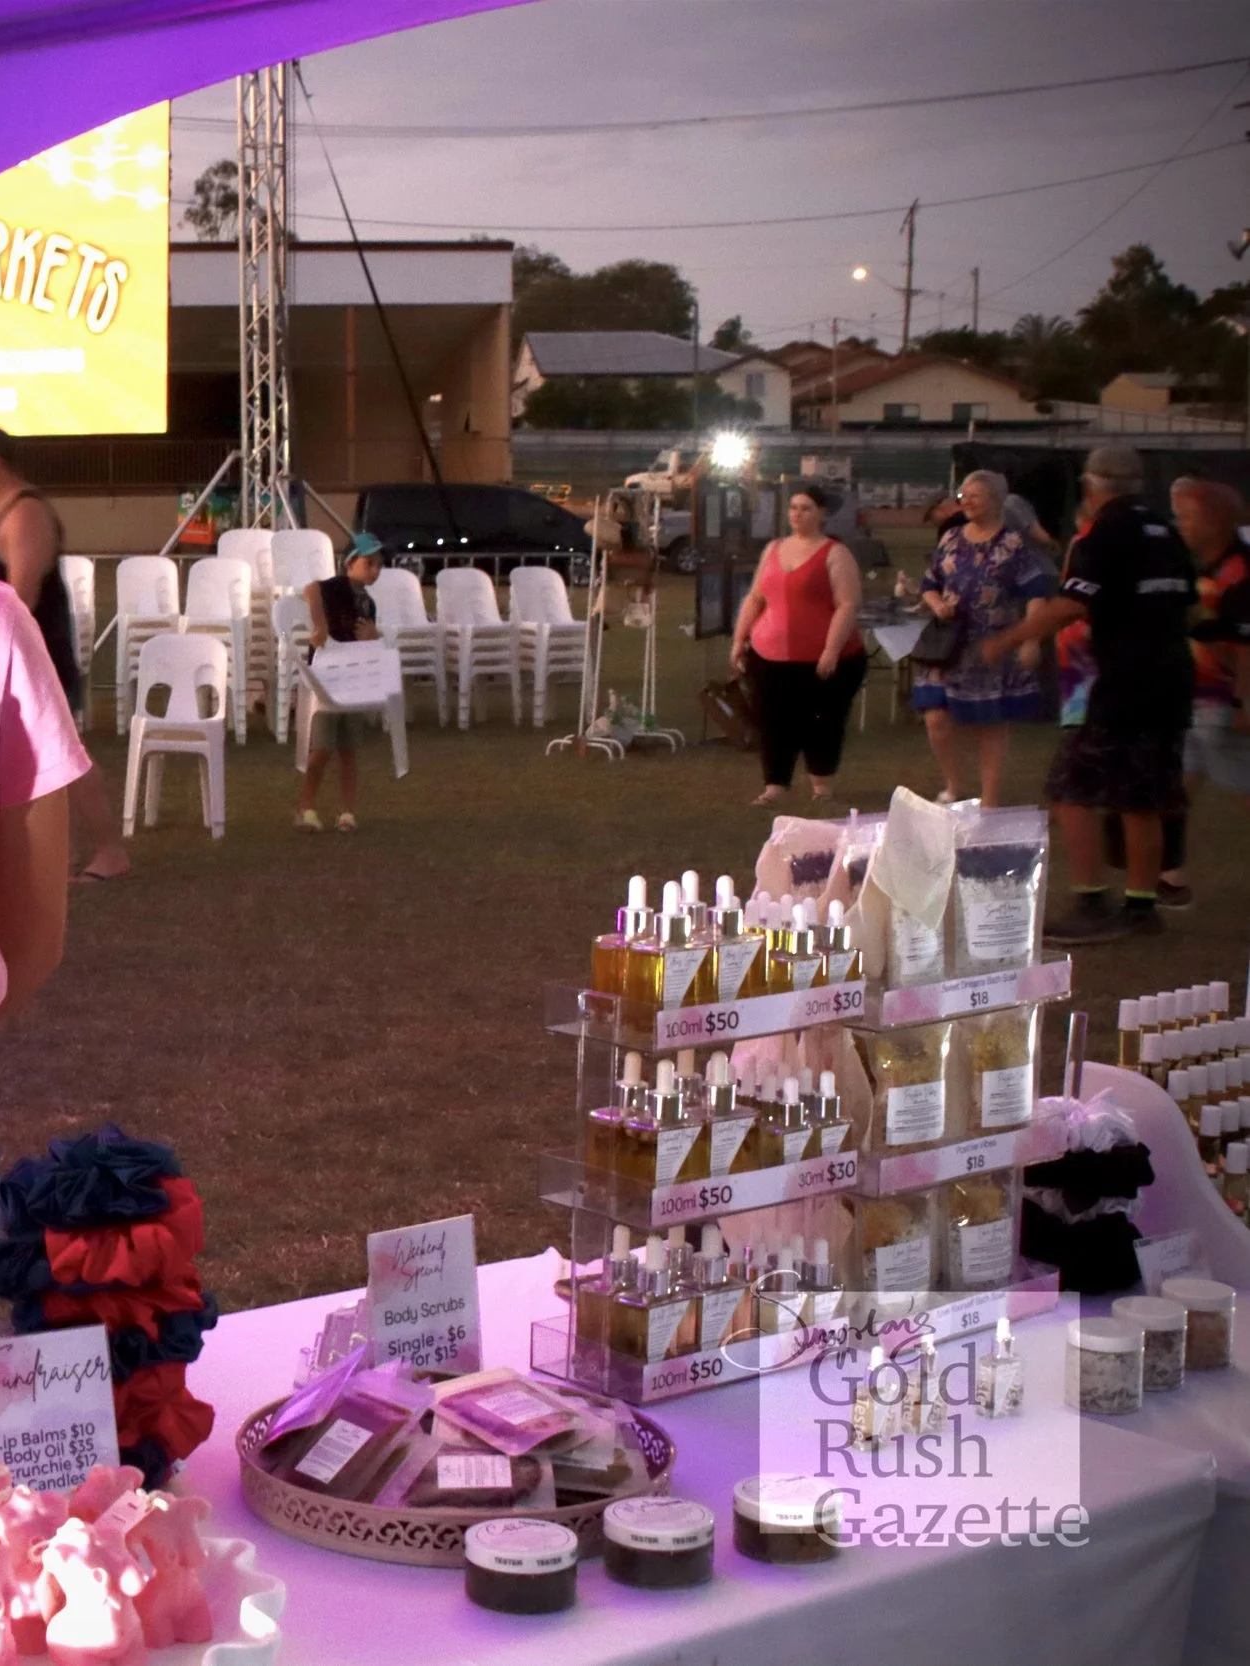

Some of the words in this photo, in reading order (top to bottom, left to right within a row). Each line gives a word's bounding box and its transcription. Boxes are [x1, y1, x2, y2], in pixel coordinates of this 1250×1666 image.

[970, 991, 989, 1009] $18
[666, 1019, 702, 1039] 100ml
[705, 1010, 739, 1036] $50
[805, 999, 831, 1016] 30ml
[832, 990, 862, 1014] $30
[966, 1154, 985, 1171] $18
[661, 1195, 696, 1216] 100ml
[699, 1184, 732, 1210] $50
[798, 1169, 824, 1188] 30ml
[827, 1160, 855, 1185] $30
[392, 1230, 446, 1271] Weekend
[402, 1253, 445, 1292] Special
[384, 1306, 418, 1325] Body
[420, 1297, 466, 1317] Scrubs
[961, 1311, 980, 1328] $18
[388, 1333, 435, 1357] Single
[447, 1325, 466, 1343] $6
[435, 1344, 459, 1363] $15
[651, 1370, 687, 1391] 100ml
[689, 1357, 722, 1384] $50
[21, 1429, 67, 1446] Balms
[70, 1422, 96, 1440] $10
[3, 1448, 41, 1465] Body
[45, 1443, 65, 1458] Oil
[68, 1437, 95, 1455] $35
[10, 1458, 72, 1480] runchie
[27, 1472, 86, 1492] Candles
[630, 1534, 659, 1545] TESTER
[672, 1534, 699, 1546] TESTER
[494, 1556, 523, 1567] TESTER
[536, 1556, 563, 1567] TESTER
